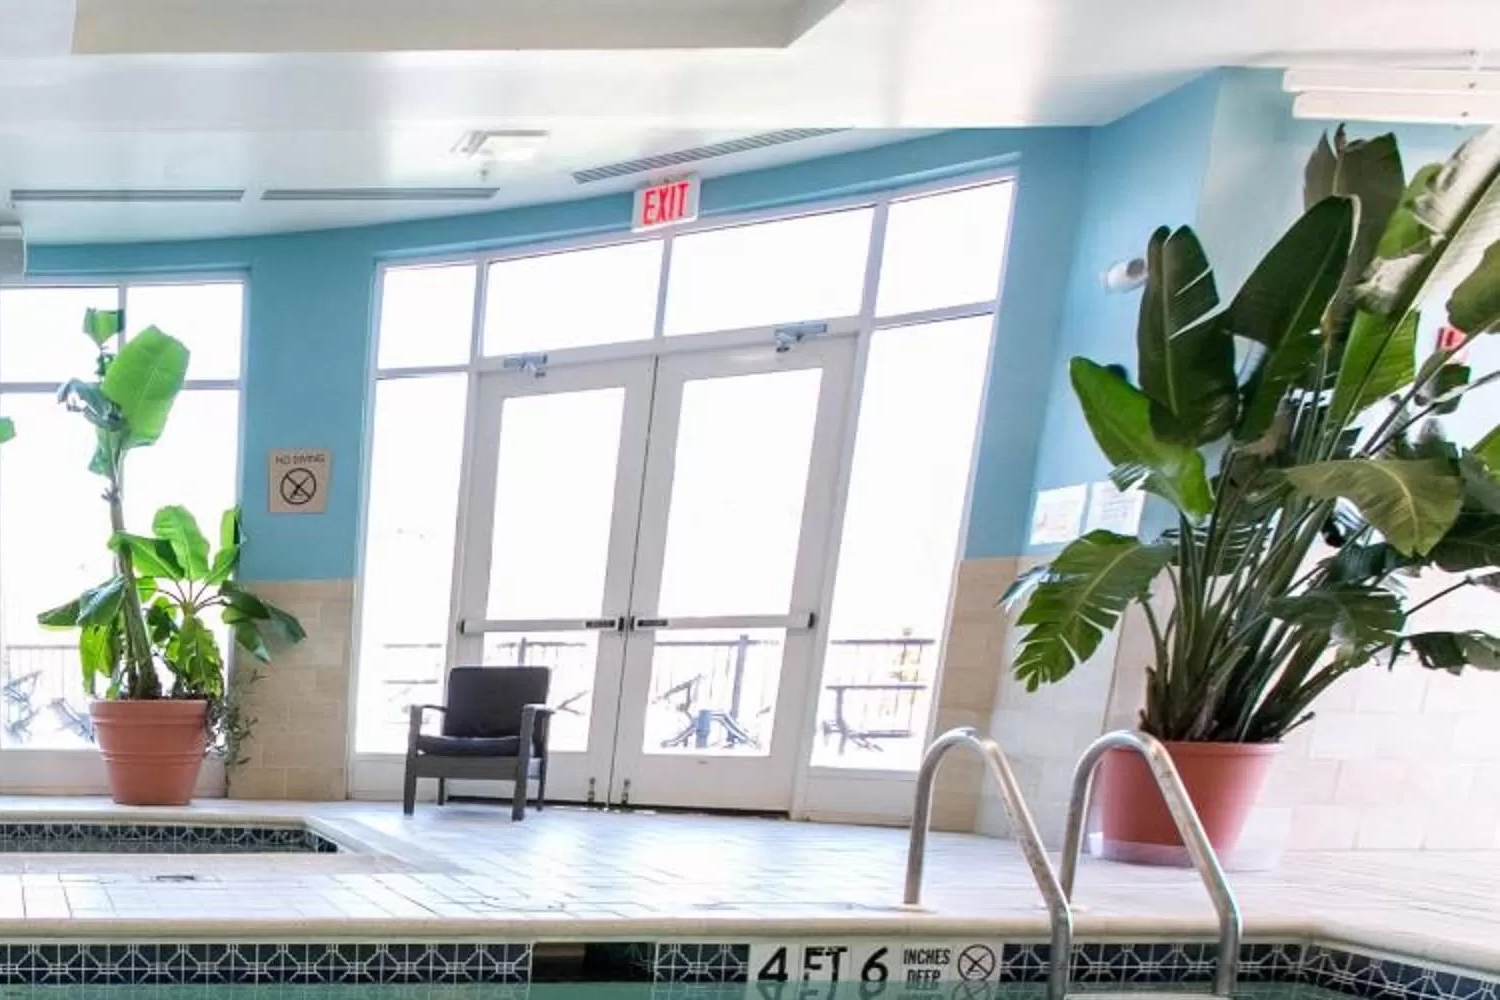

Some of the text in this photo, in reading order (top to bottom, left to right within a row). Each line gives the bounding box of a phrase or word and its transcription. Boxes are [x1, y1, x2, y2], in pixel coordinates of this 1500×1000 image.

[643, 183, 690, 225] EXIT
[275, 453, 325, 465] NO DIVING
[757, 946, 951, 983] 4 FT 6 INCHES
